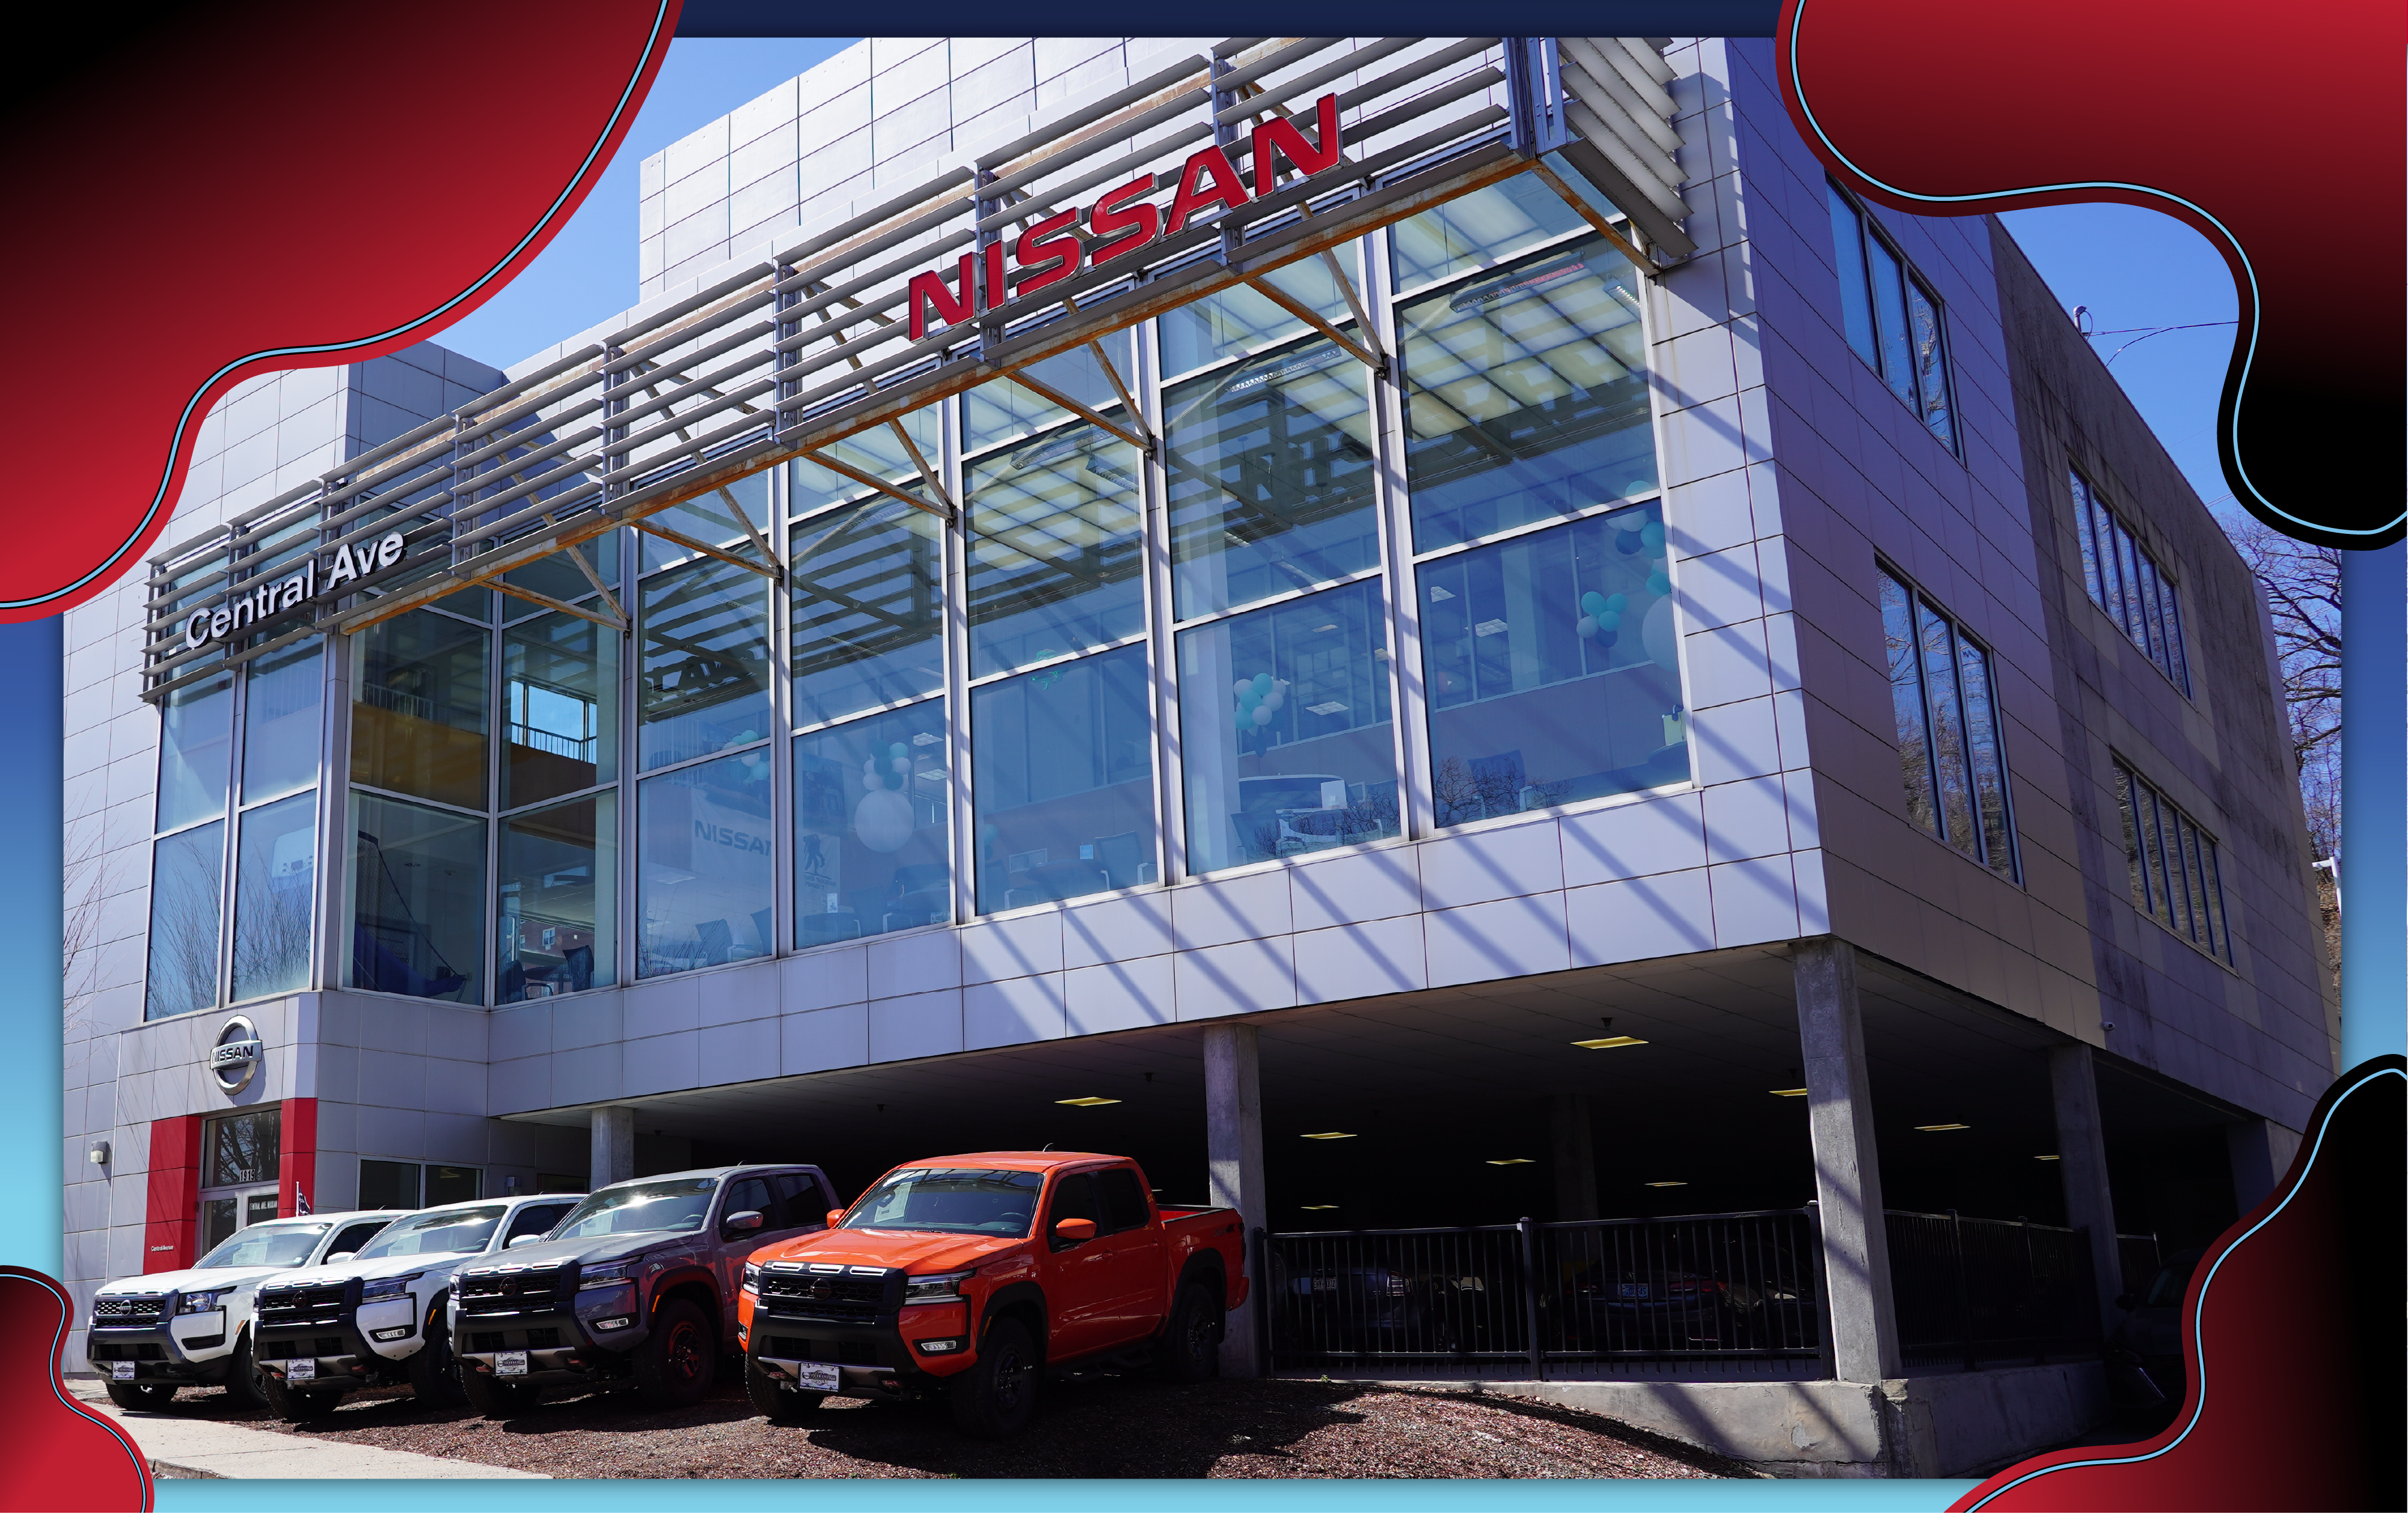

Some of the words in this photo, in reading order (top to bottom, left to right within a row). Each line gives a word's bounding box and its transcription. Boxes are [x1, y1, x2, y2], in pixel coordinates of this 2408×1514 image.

[908, 93, 1343, 343] NISSAN
[185, 559, 317, 648] Central
[326, 532, 406, 590] Ave
[212, 1045, 254, 1065] NISSAN
[240, 1169, 255, 1181] 1919
